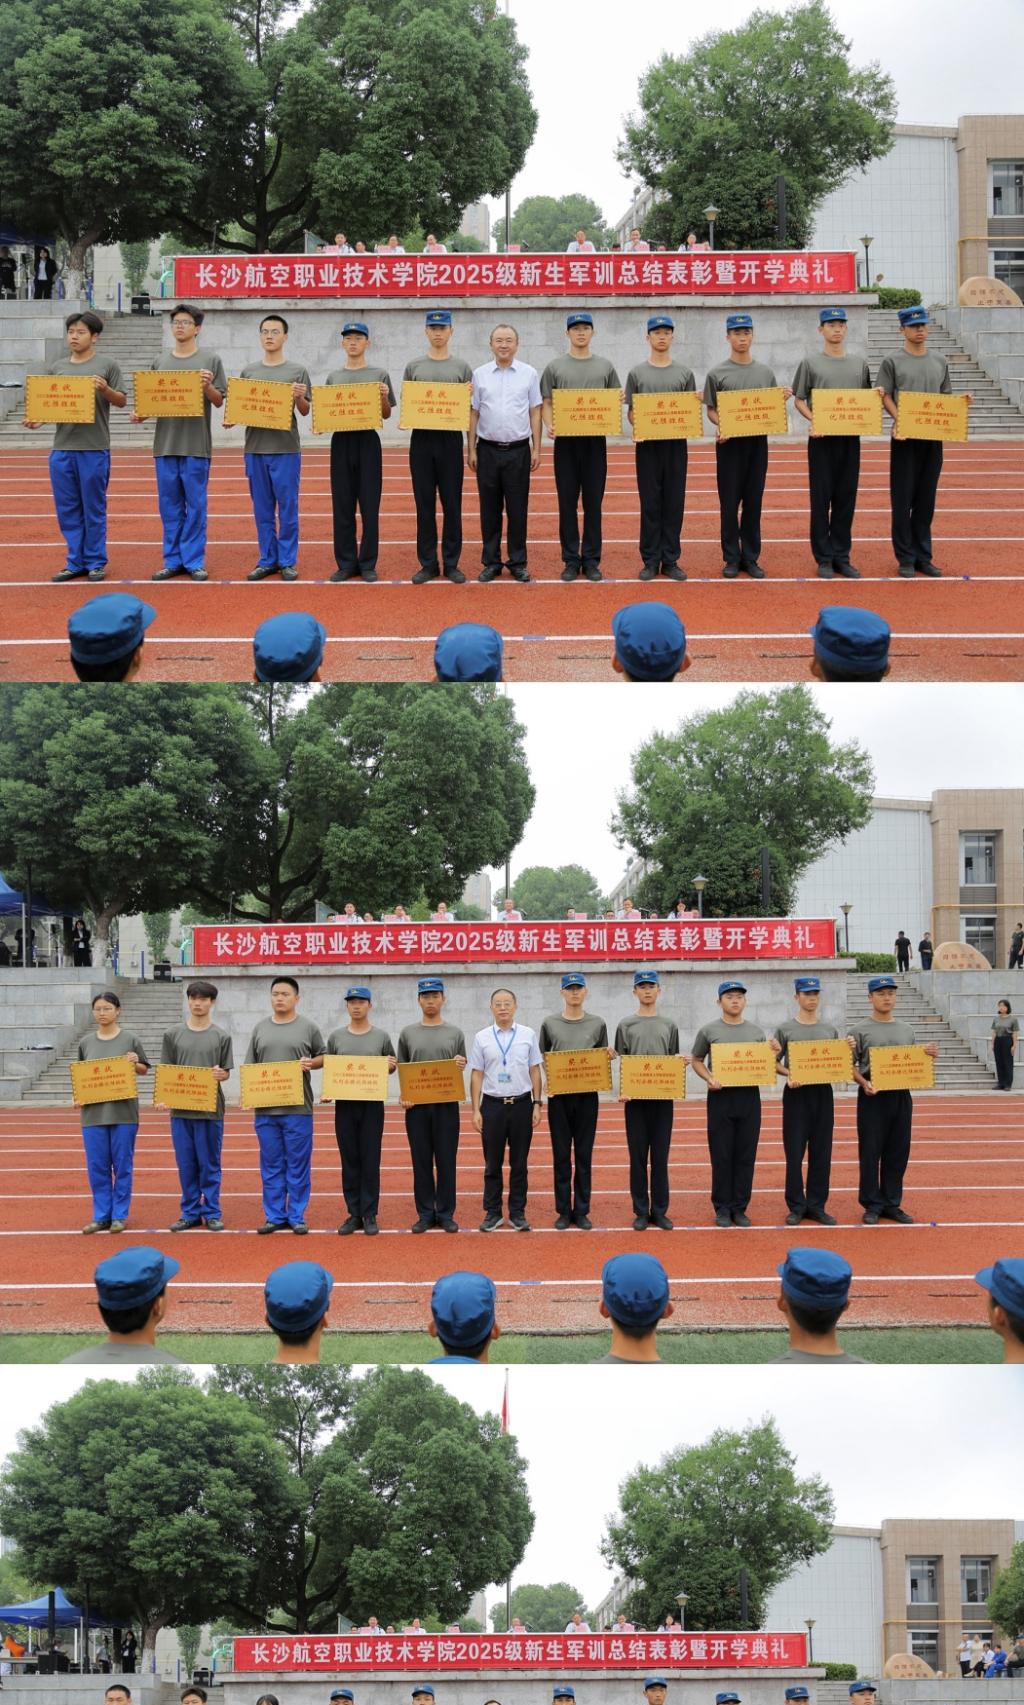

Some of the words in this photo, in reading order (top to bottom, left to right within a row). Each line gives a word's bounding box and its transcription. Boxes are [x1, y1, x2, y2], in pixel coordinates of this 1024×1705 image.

[195, 258, 834, 288] 长沙航空职业技术学院2025级新生军训总结表彰暨开学典礼
[212, 924, 815, 956] 长沙航空职业技术学院2025级新生军训总结表彰暨开学典礼
[251, 1636, 789, 1664] 长沙航空职业技术学院2025级新生军训总结表彰暨开学典礼
